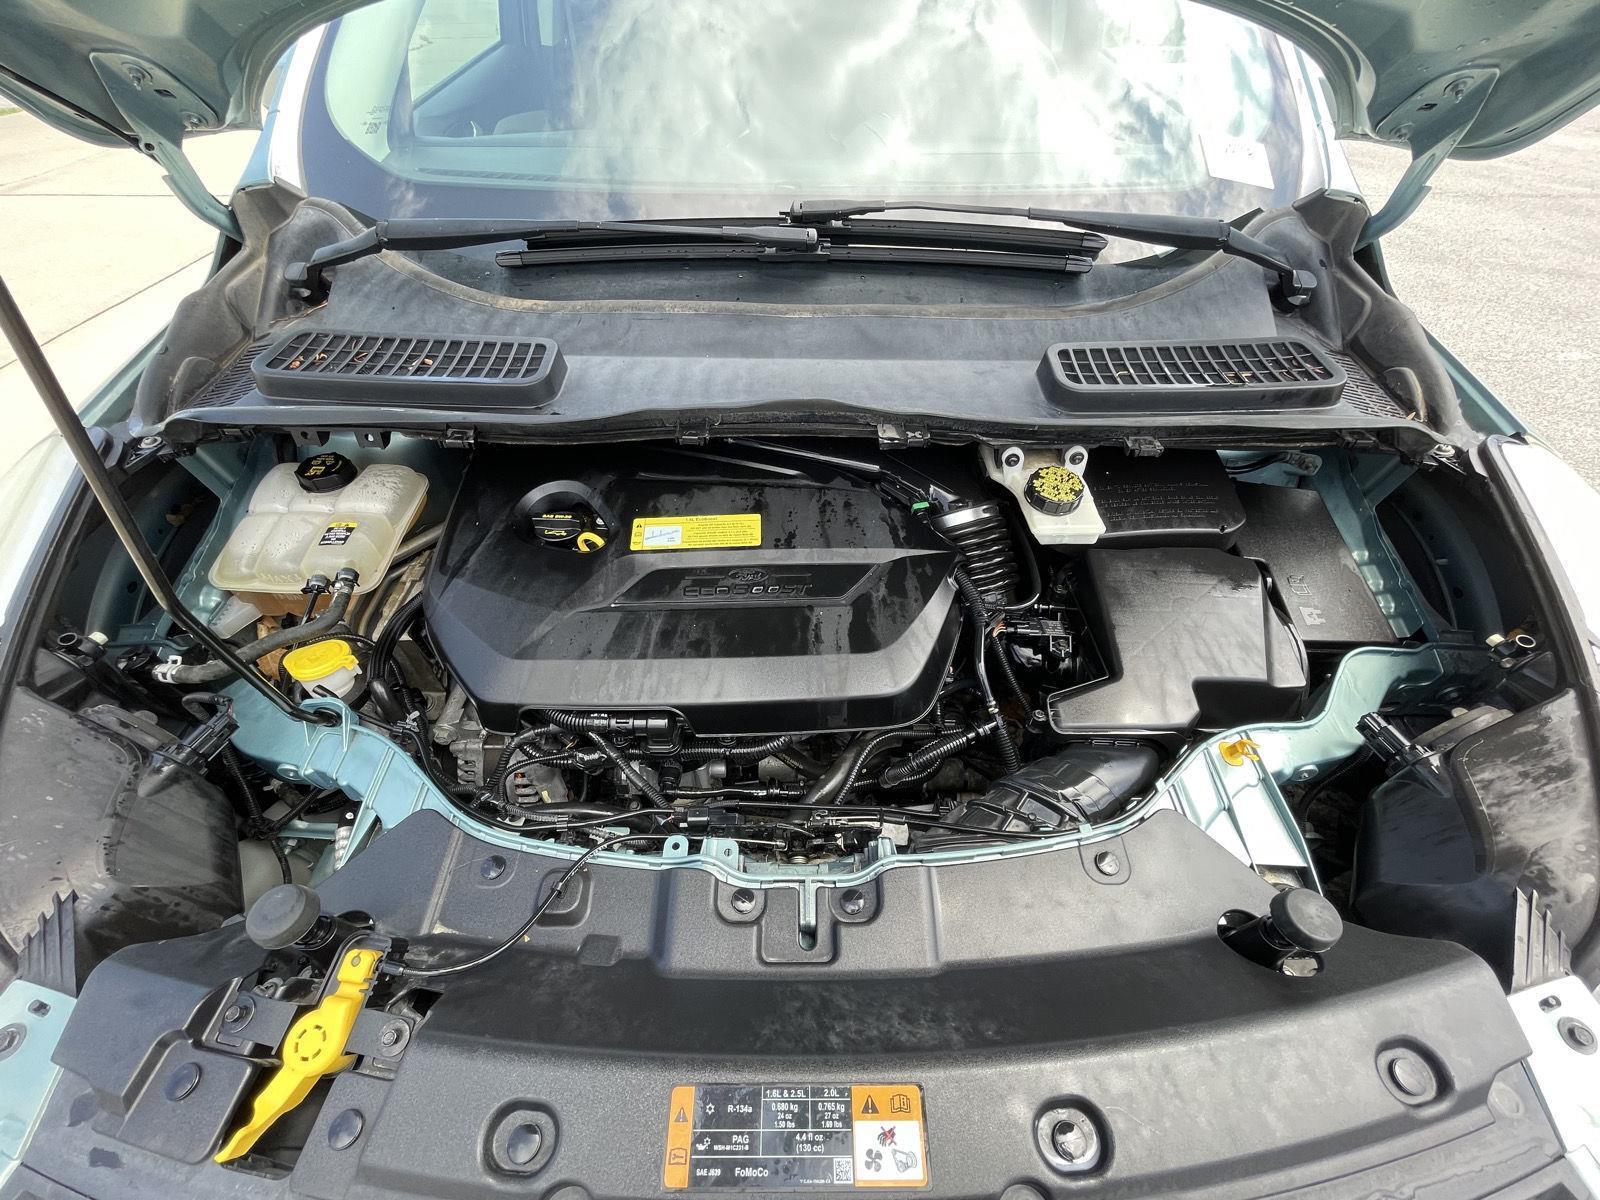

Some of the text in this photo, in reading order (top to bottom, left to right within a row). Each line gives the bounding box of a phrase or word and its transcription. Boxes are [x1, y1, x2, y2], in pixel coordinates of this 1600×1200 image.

[683, 584, 813, 600] ECOBOOST
[766, 1089, 806, 1098] 1.6L & 2.5L
[824, 1088, 840, 1097] 2.0L
[727, 1104, 753, 1113] R-134a
[790, 1102, 799, 1113] kg
[818, 1102, 845, 1113] 0.765 kg
[777, 1112, 785, 1120] 24
[824, 1112, 831, 1120] 27
[787, 1120, 796, 1128] lbs
[834, 1120, 843, 1128] lbs
[732, 1134, 750, 1144] PAG
[795, 1132, 807, 1141] 4.4
[808, 1132, 813, 1141] fl
[796, 1143, 825, 1154] (130 cc)
[696, 1168, 708, 1176] SAE
[734, 1167, 769, 1177] FoMoCo
